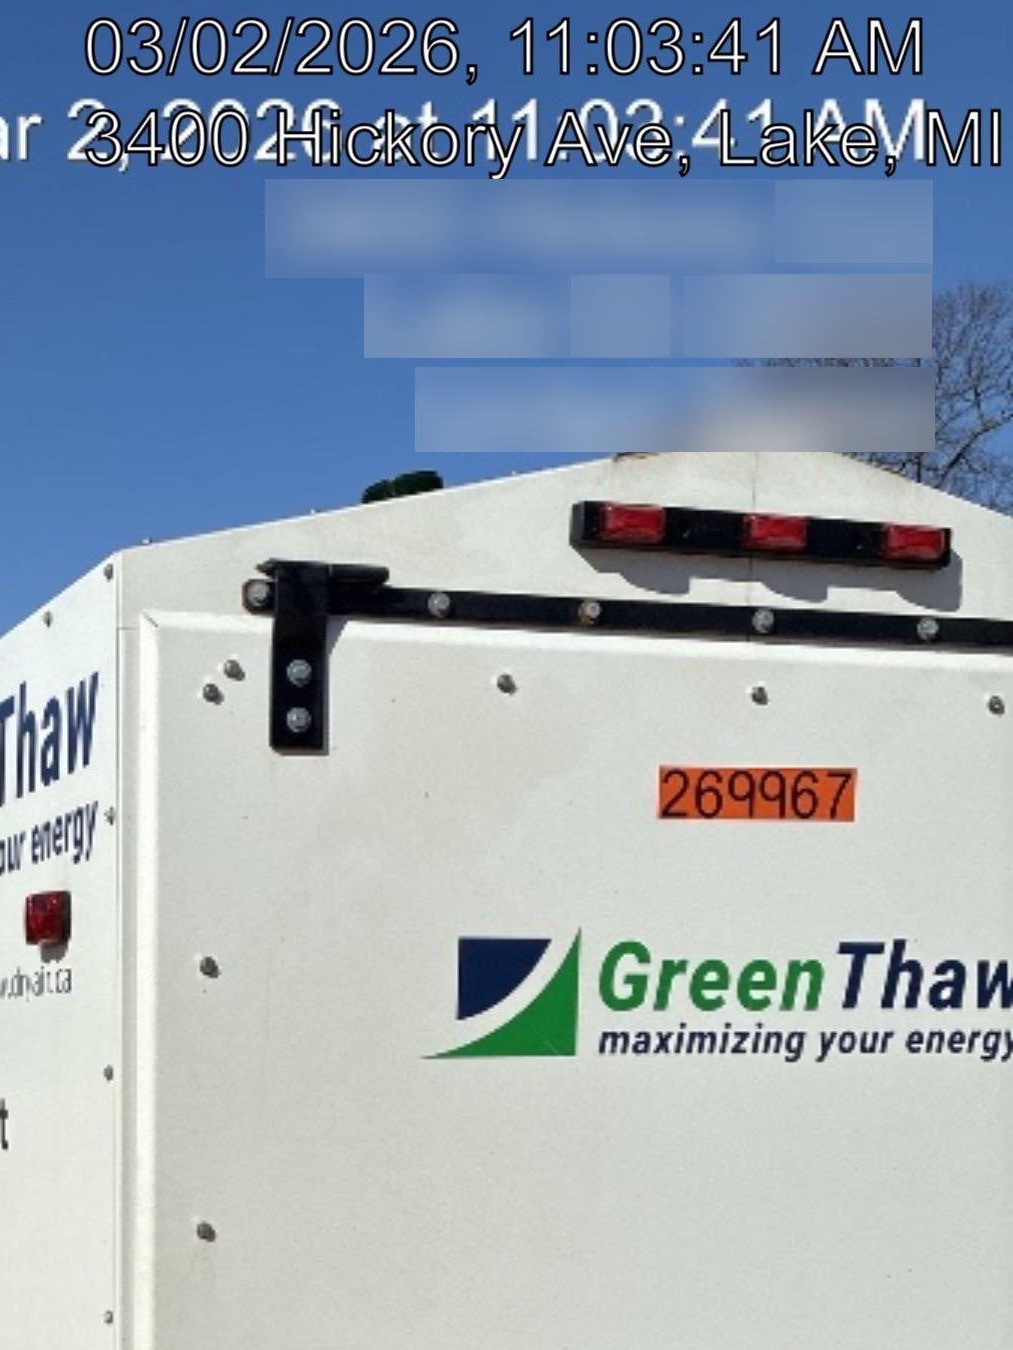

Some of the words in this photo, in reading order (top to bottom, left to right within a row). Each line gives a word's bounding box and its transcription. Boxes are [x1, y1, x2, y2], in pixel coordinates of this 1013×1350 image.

[661, 769, 852, 819] 269967
[31, 800, 99, 864] energy
[598, 1022, 807, 1063] maximizing
[815, 1027, 895, 1064] your
